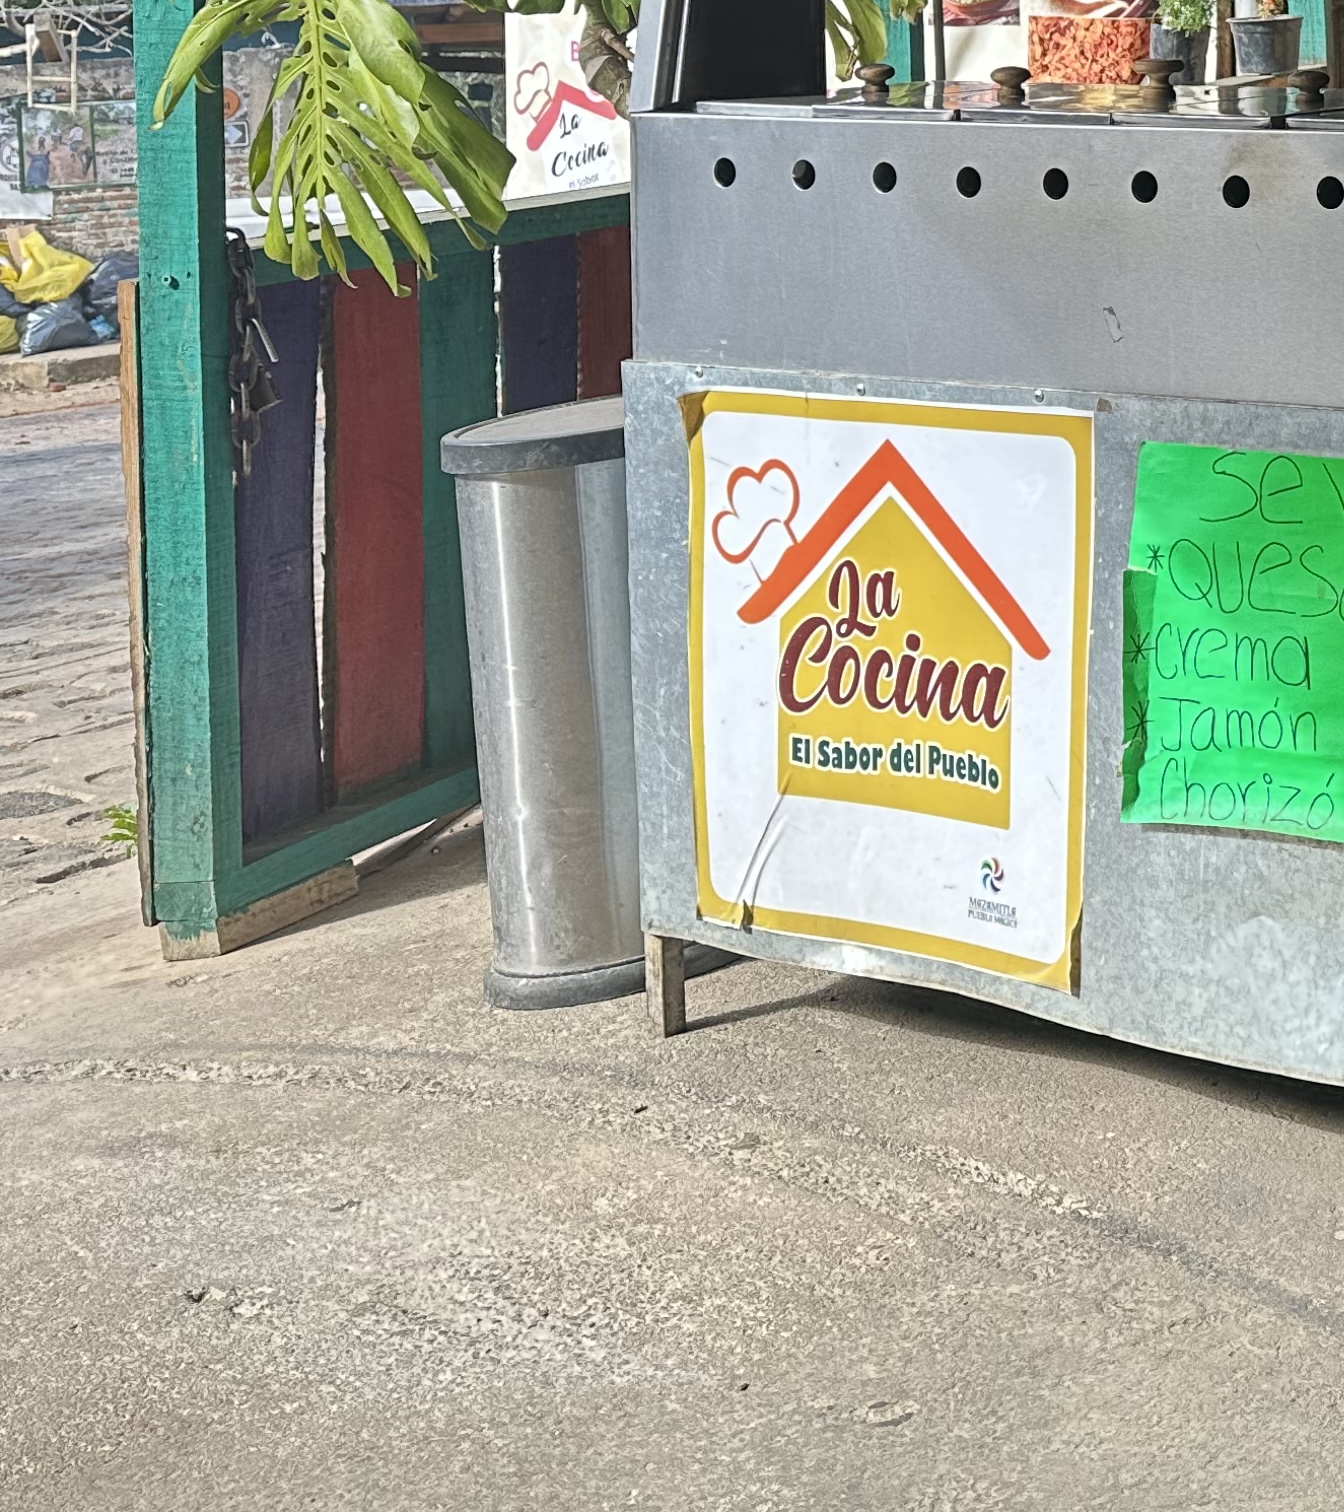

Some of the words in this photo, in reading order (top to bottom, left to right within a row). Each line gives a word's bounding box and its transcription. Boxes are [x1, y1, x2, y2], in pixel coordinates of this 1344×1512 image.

[559, 113, 582, 139] La
[551, 141, 609, 177] Cocina
[828, 559, 900, 638] La
[779, 617, 1009, 730] Cocina
[791, 737, 811, 765] El
[817, 739, 884, 774] Sabor
[888, 742, 922, 775] del
[928, 746, 1001, 792] Pueblo
